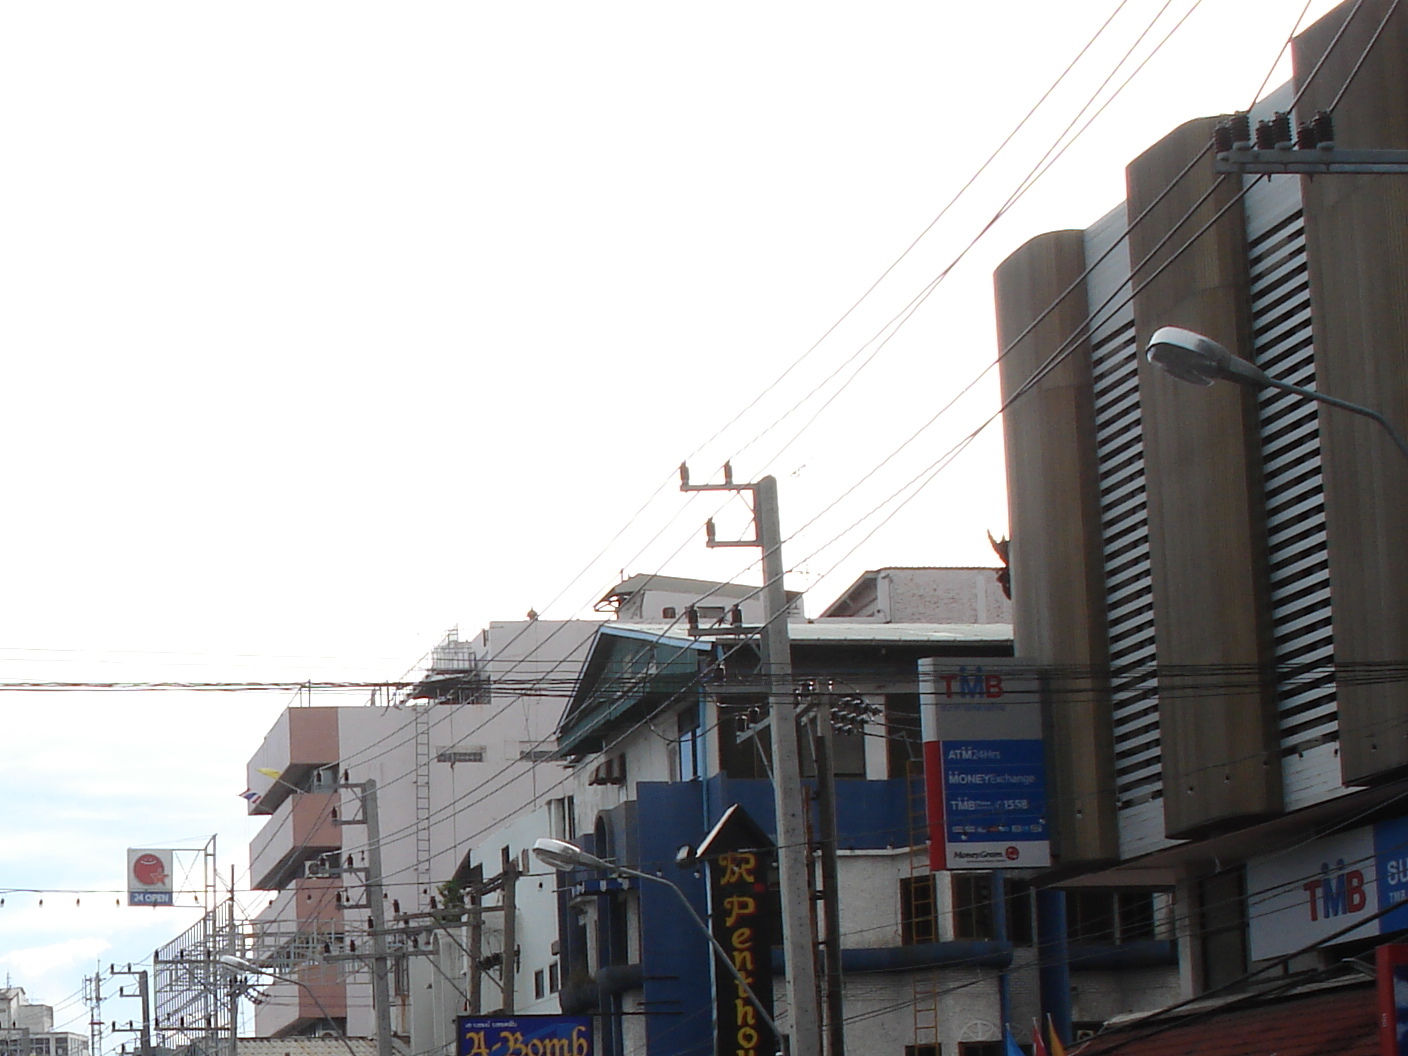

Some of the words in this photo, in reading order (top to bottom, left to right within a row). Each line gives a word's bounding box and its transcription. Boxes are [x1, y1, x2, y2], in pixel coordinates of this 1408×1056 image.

[942, 667, 1004, 698] TMB
[145, 894, 169, 903] OPEN
[1303, 858, 1367, 922] TMB
